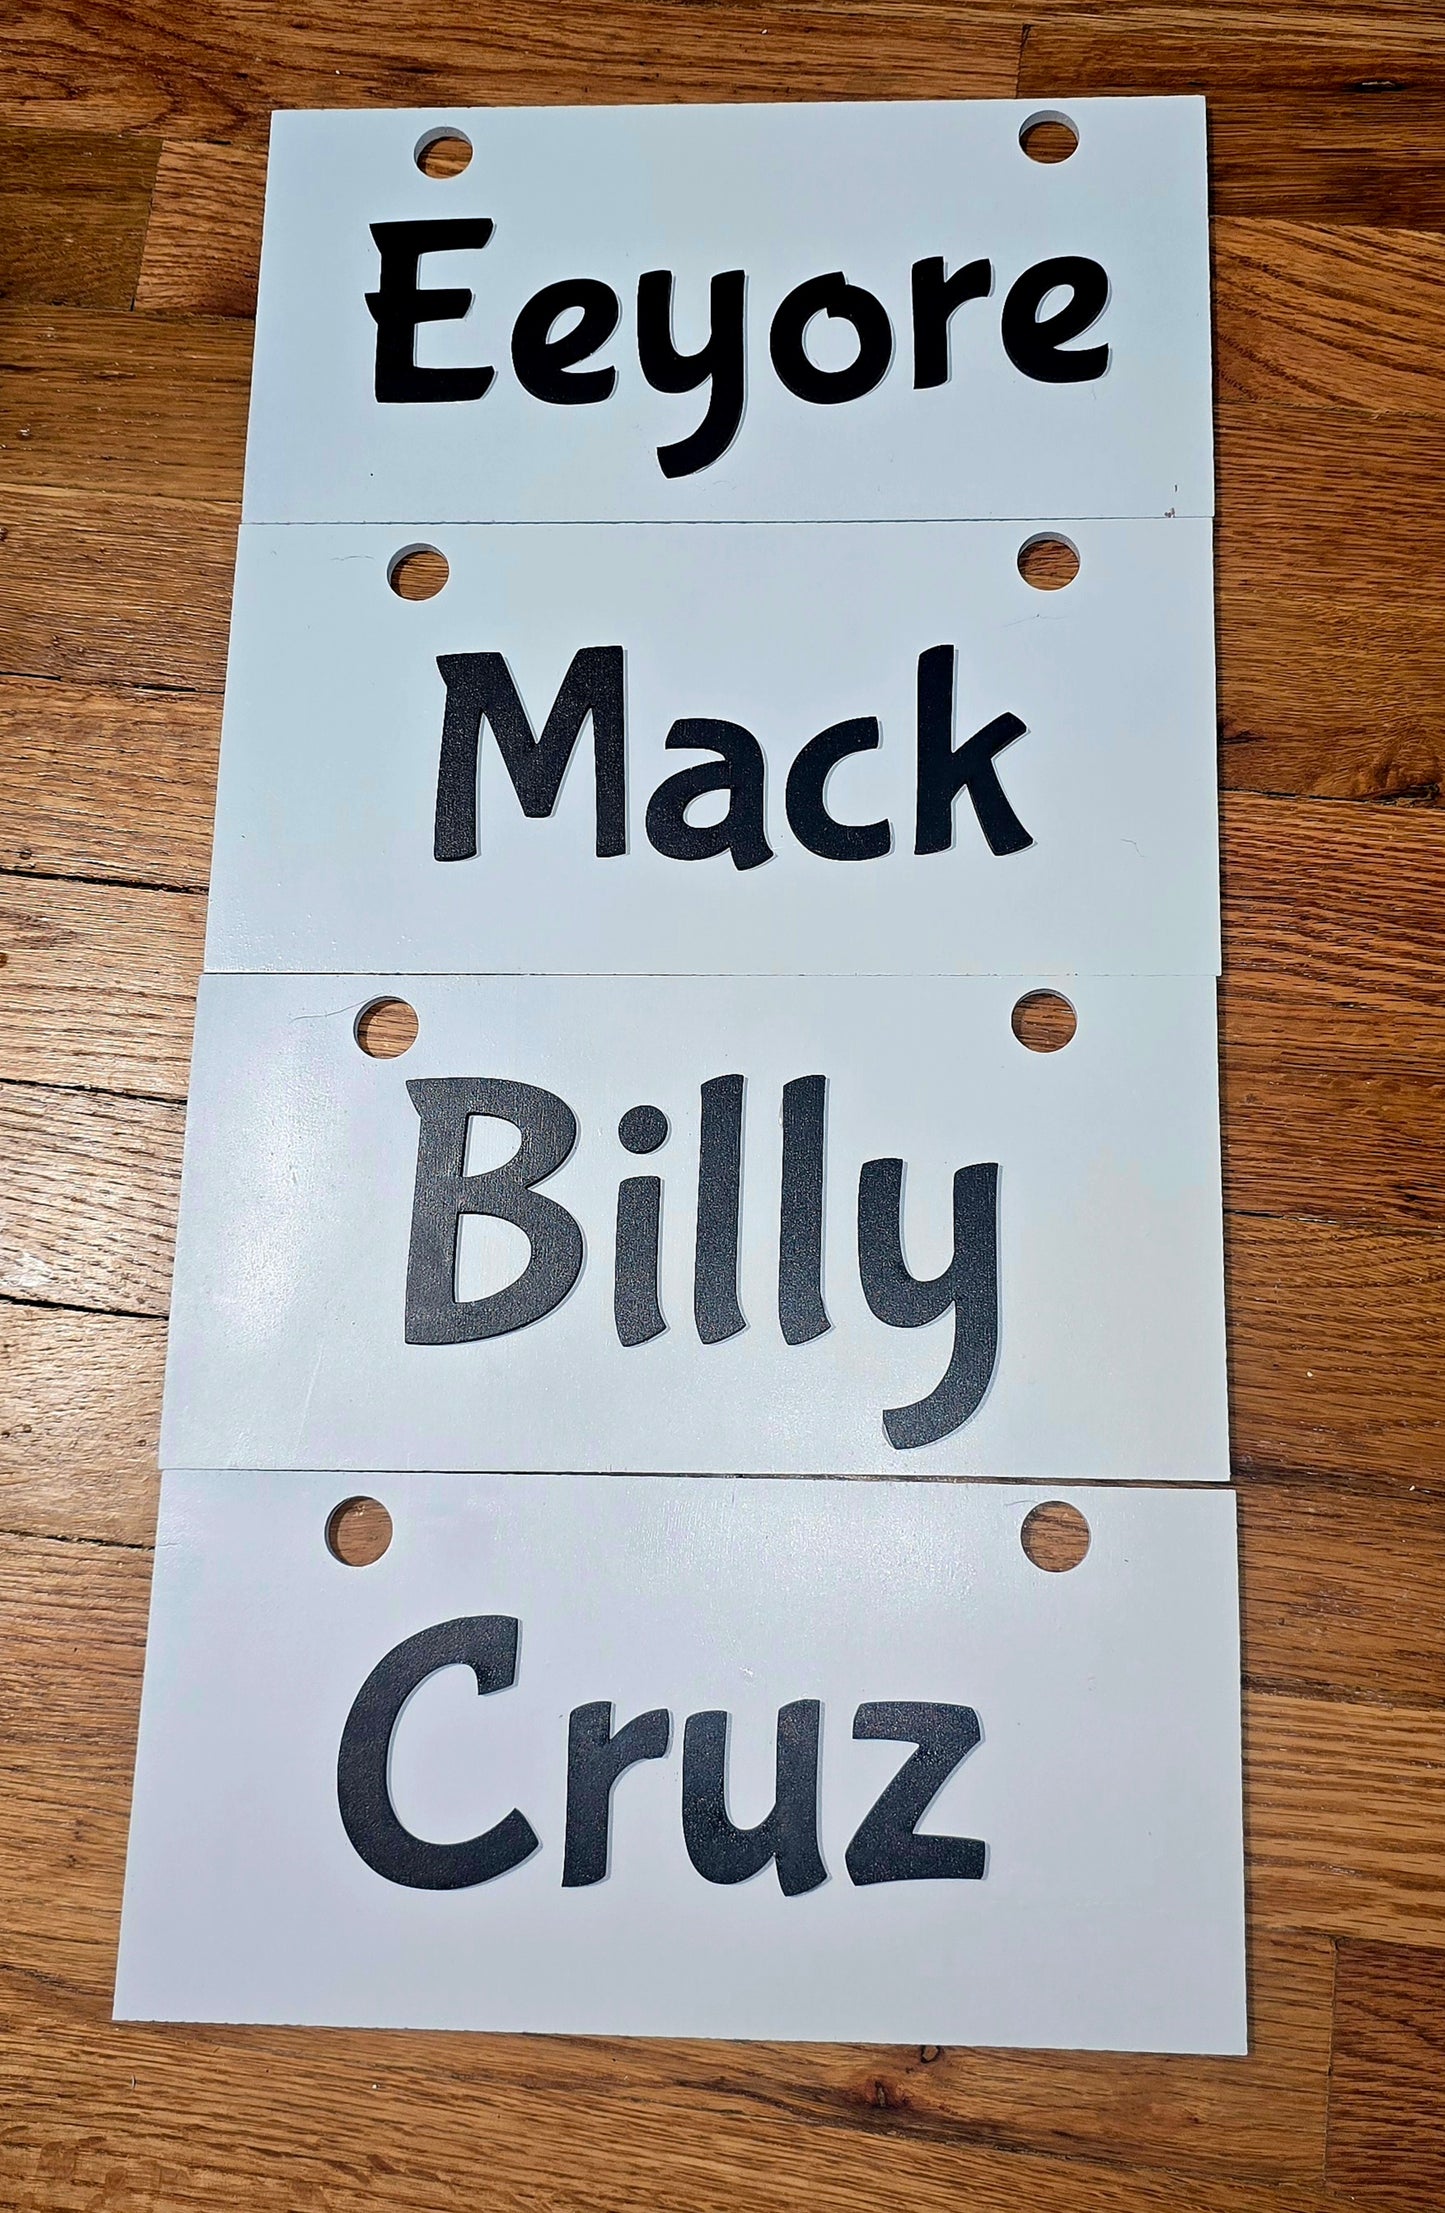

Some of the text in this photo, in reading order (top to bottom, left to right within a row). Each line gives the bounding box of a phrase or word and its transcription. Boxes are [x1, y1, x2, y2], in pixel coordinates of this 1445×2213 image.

[365, 217, 1111, 479] Eeyore
[433, 644, 1035, 872] Mack
[404, 1073, 1001, 1451] Billy
[337, 1614, 988, 1897] Cruz
